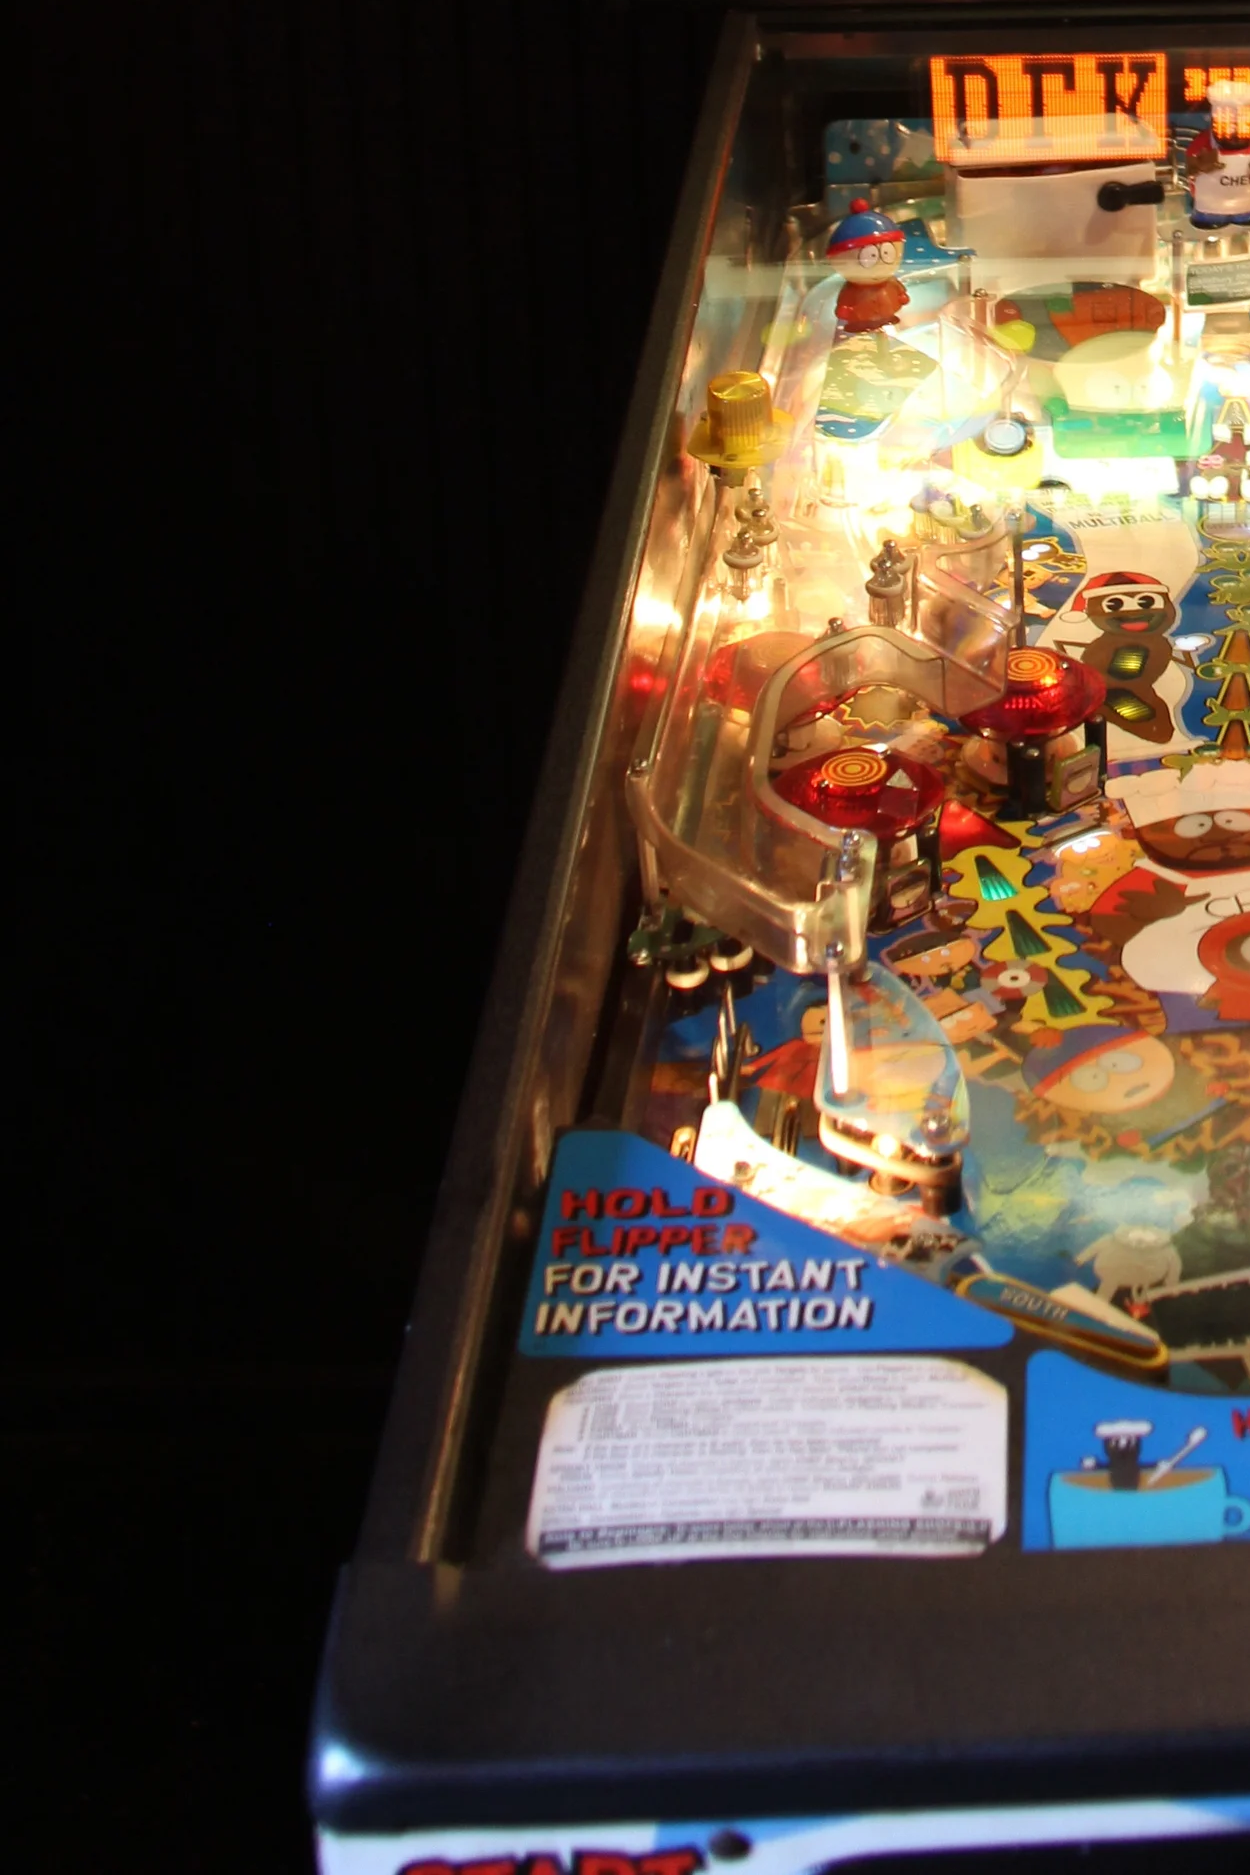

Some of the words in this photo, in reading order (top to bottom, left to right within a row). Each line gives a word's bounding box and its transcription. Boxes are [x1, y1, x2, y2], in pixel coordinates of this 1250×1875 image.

[1069, 511, 1176, 530] MULTIBALL
[560, 1187, 734, 1219] HOLD
[551, 1223, 758, 1258] FLIPPER
[544, 1262, 641, 1296] FOR
[656, 1257, 868, 1294] INSTANT
[535, 1295, 874, 1335] INFORMATION
